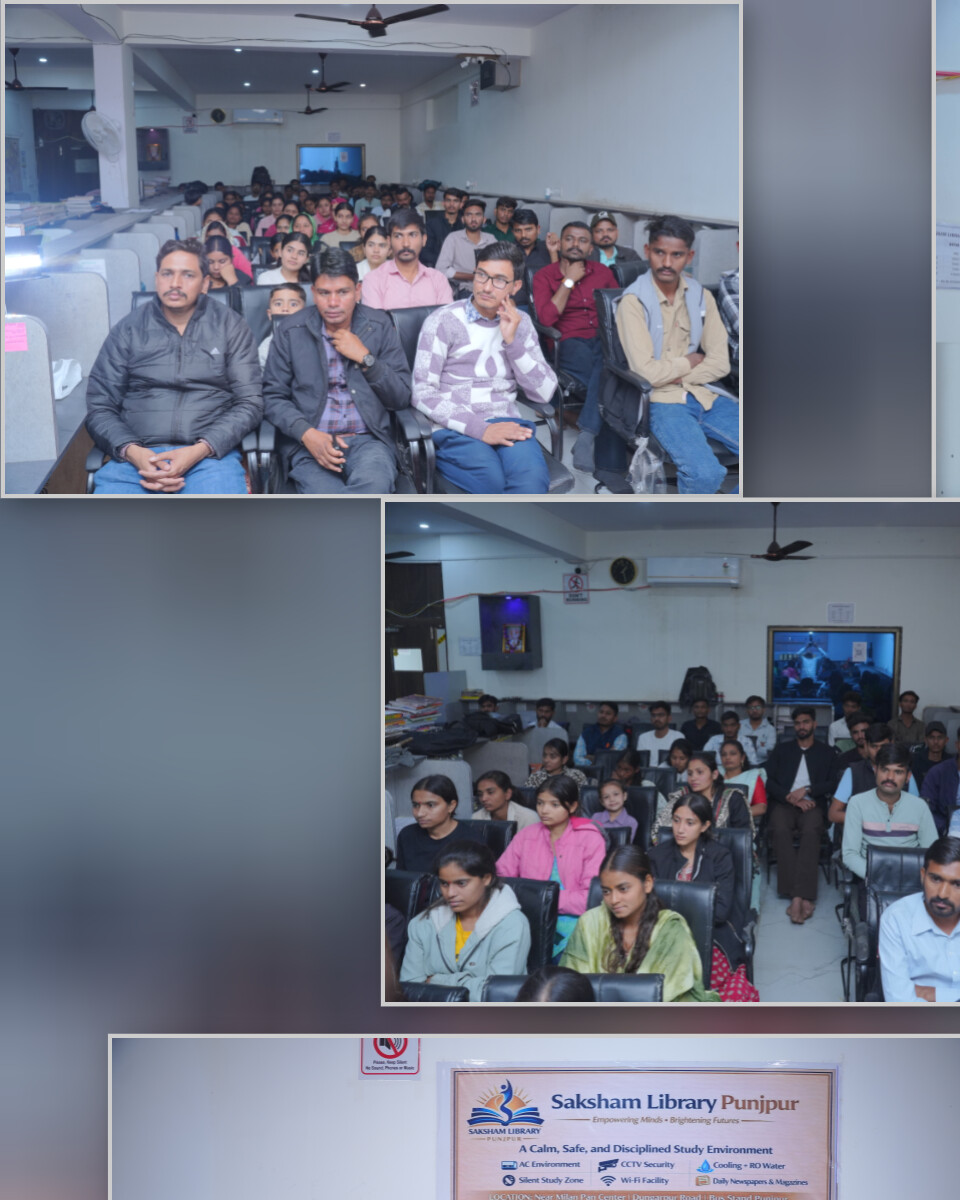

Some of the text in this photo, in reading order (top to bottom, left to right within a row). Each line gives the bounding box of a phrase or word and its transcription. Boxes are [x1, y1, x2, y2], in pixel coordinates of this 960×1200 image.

[551, 1094, 799, 1114] Saksham Library Punjpur
[593, 1116, 639, 1125] Empowering
[669, 1117, 711, 1125] Brightening
[519, 1144, 773, 1155] A Calm, Safe, and Disciplined Study Environment
[643, 1161, 675, 1169] Security
[713, 1162, 743, 1171] Cooling
[541, 1177, 563, 1185] Study
[642, 1177, 669, 1185] Facility
[713, 1178, 729, 1186] Daily
[775, 1179, 808, 1187] Magazines
